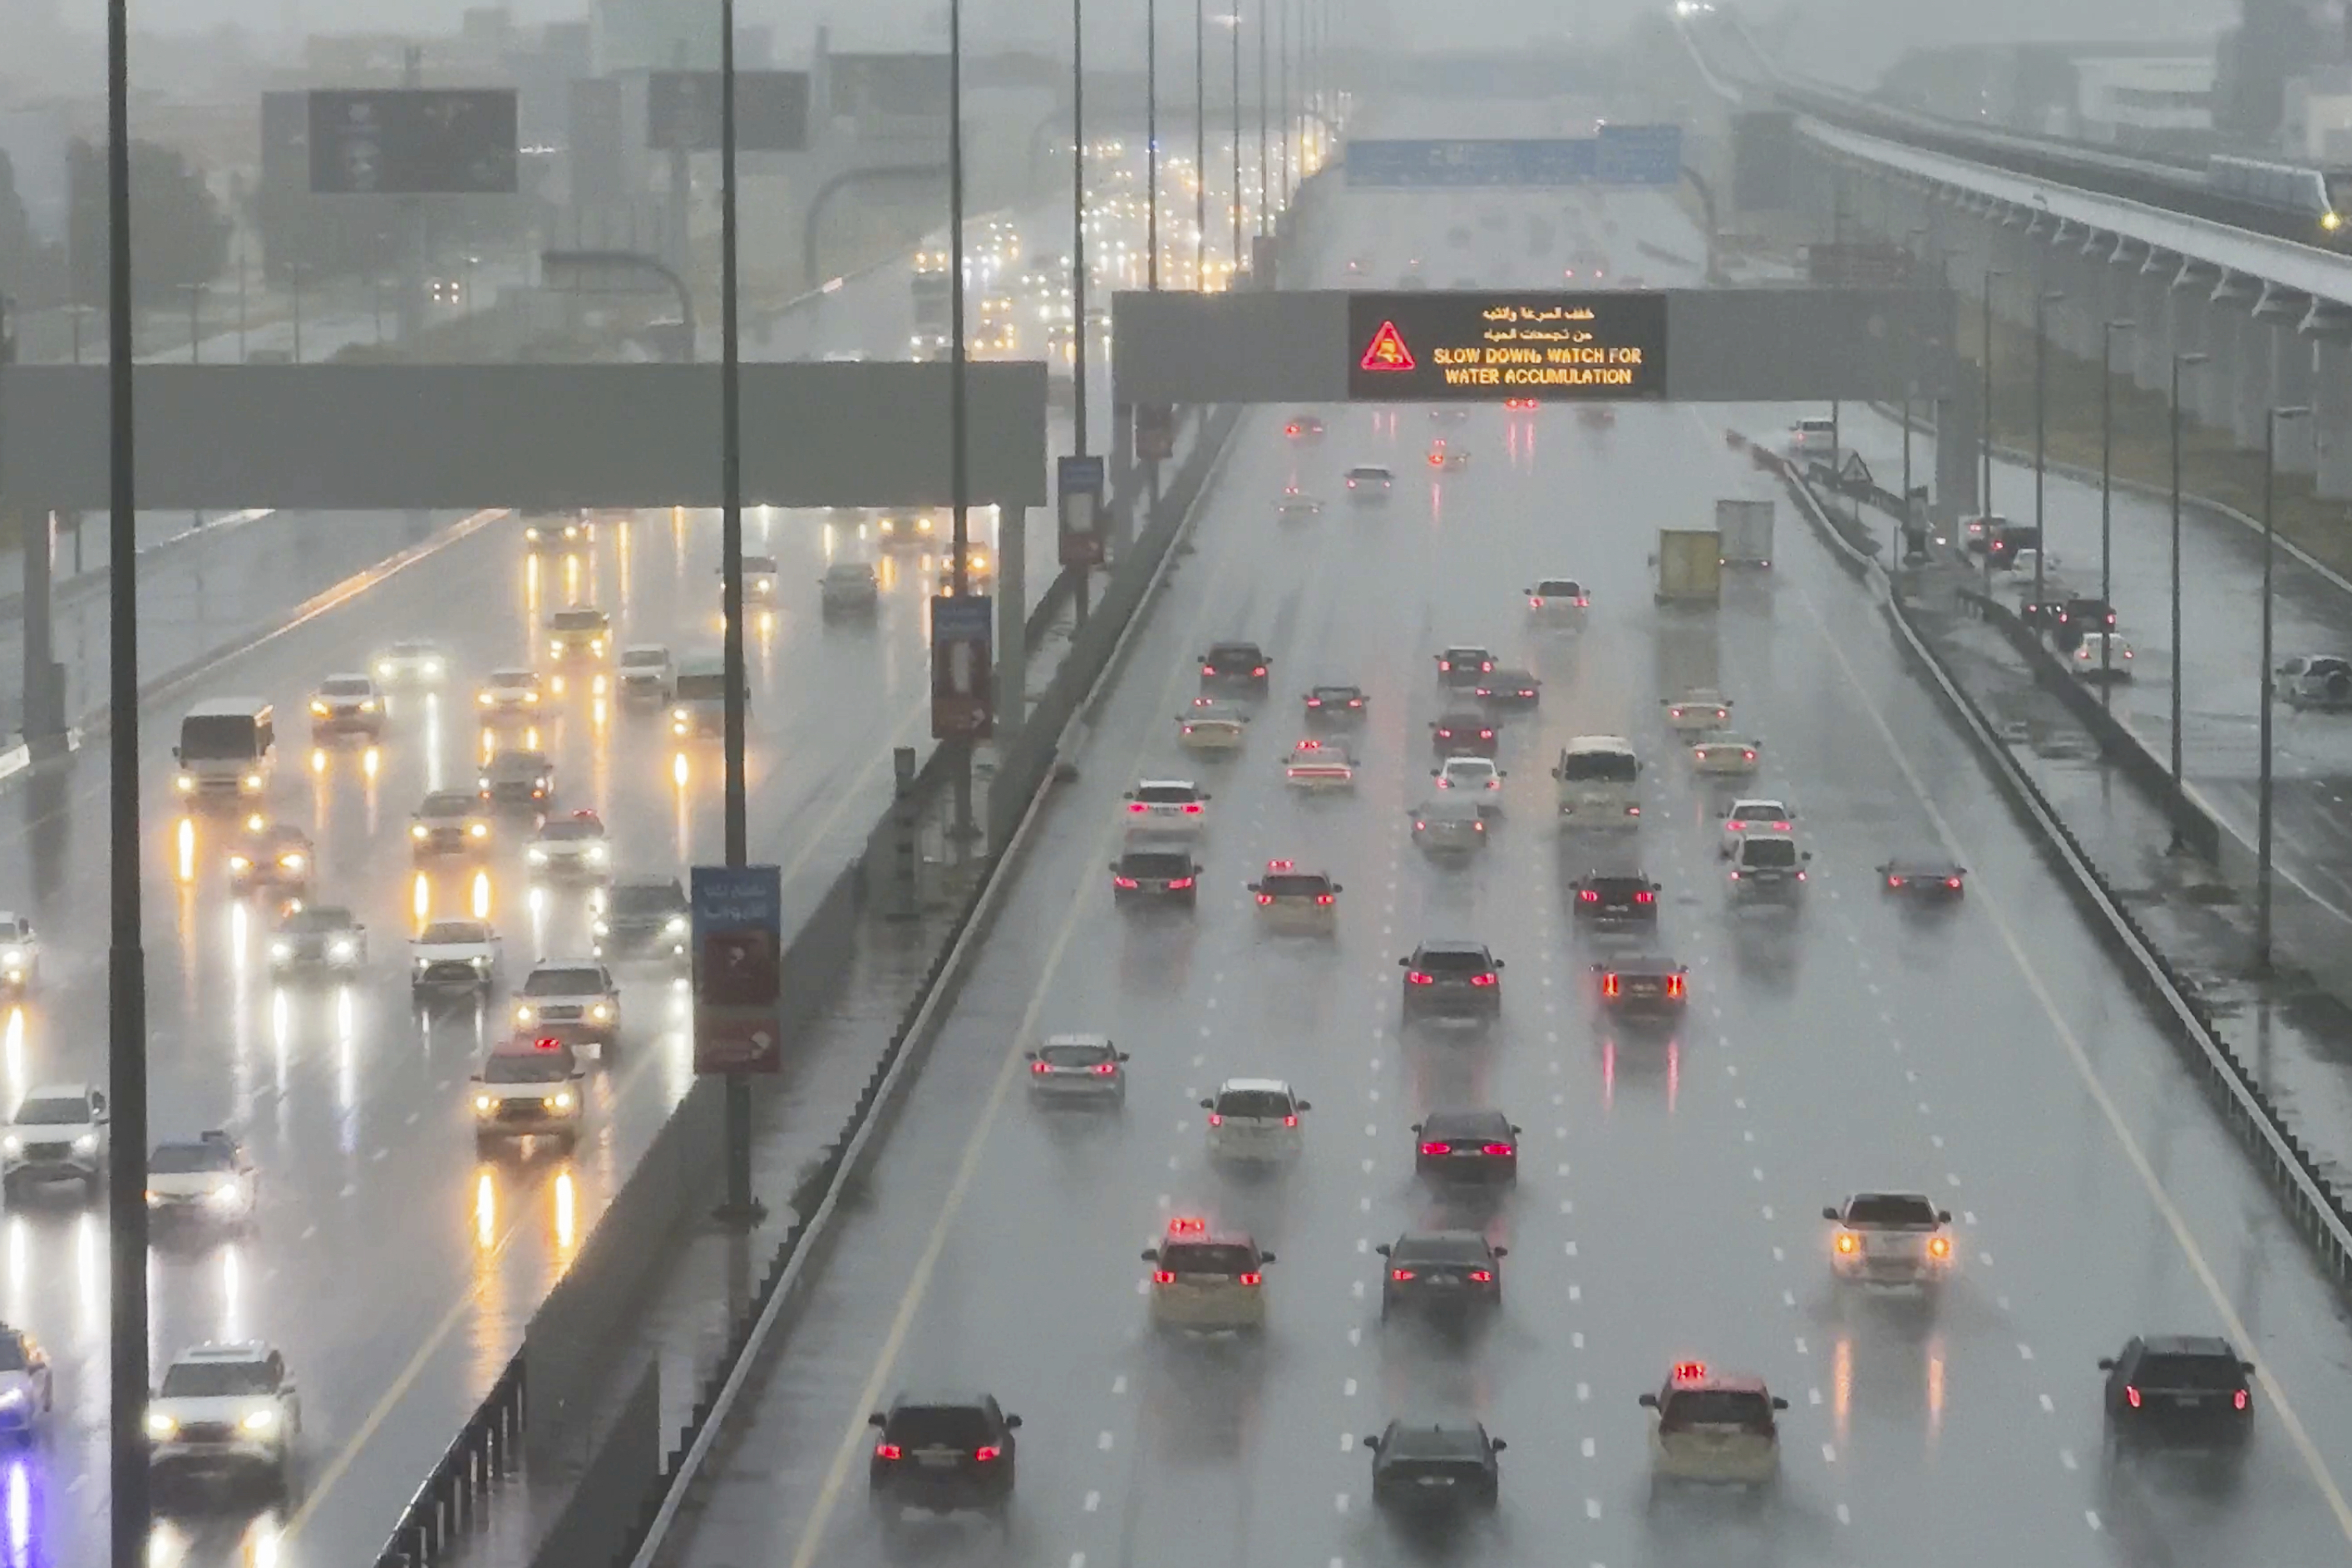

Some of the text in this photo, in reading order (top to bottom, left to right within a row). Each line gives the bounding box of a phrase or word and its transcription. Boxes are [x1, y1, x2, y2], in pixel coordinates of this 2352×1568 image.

[1433, 348, 1481, 364] SLOW
[1546, 348, 1604, 364] WATCH
[1609, 348, 1642, 364] FOR
[1445, 368, 1632, 384] WATER ACCUMULATION
